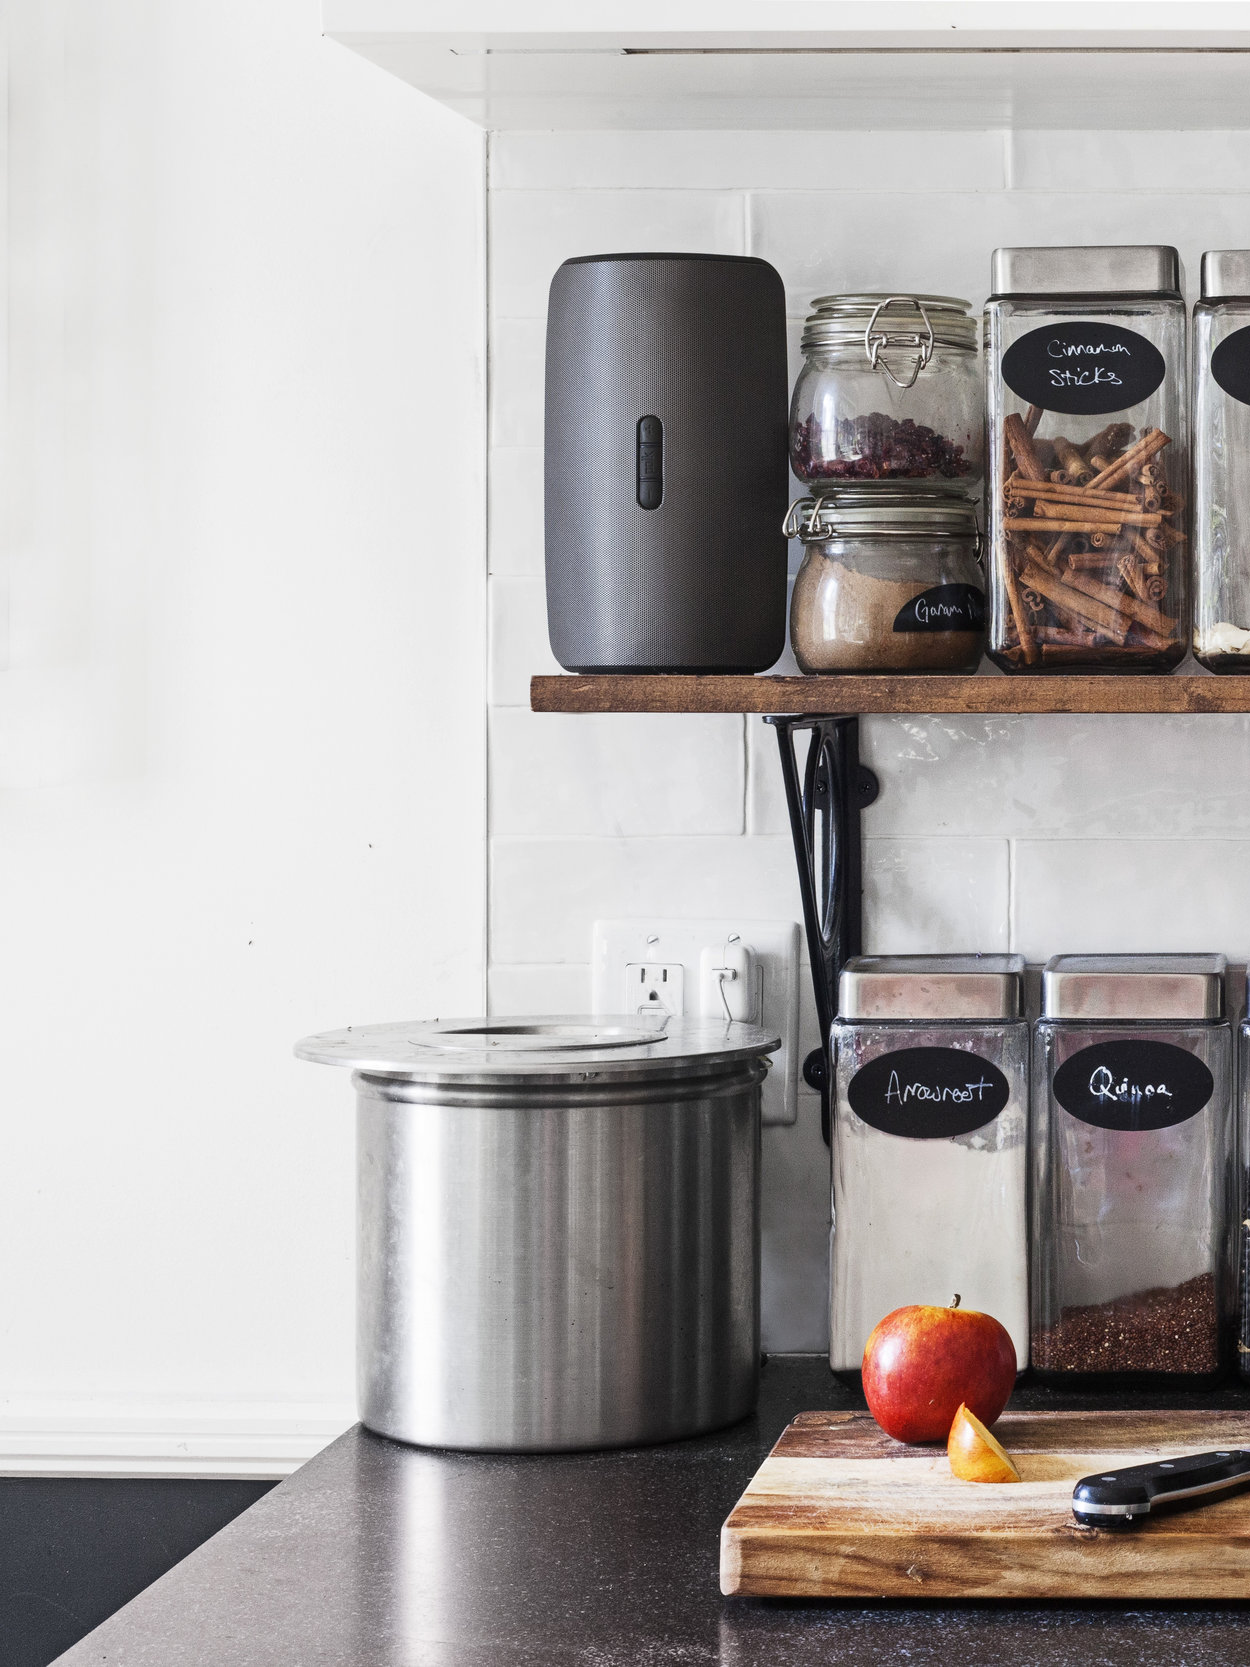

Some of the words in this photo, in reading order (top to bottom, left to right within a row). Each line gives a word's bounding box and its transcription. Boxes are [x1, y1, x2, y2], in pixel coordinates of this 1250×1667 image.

[1046, 339, 1131, 358] Cinnamon
[1048, 367, 1123, 387] Sticks
[1089, 1065, 1173, 1101] Quinoa
